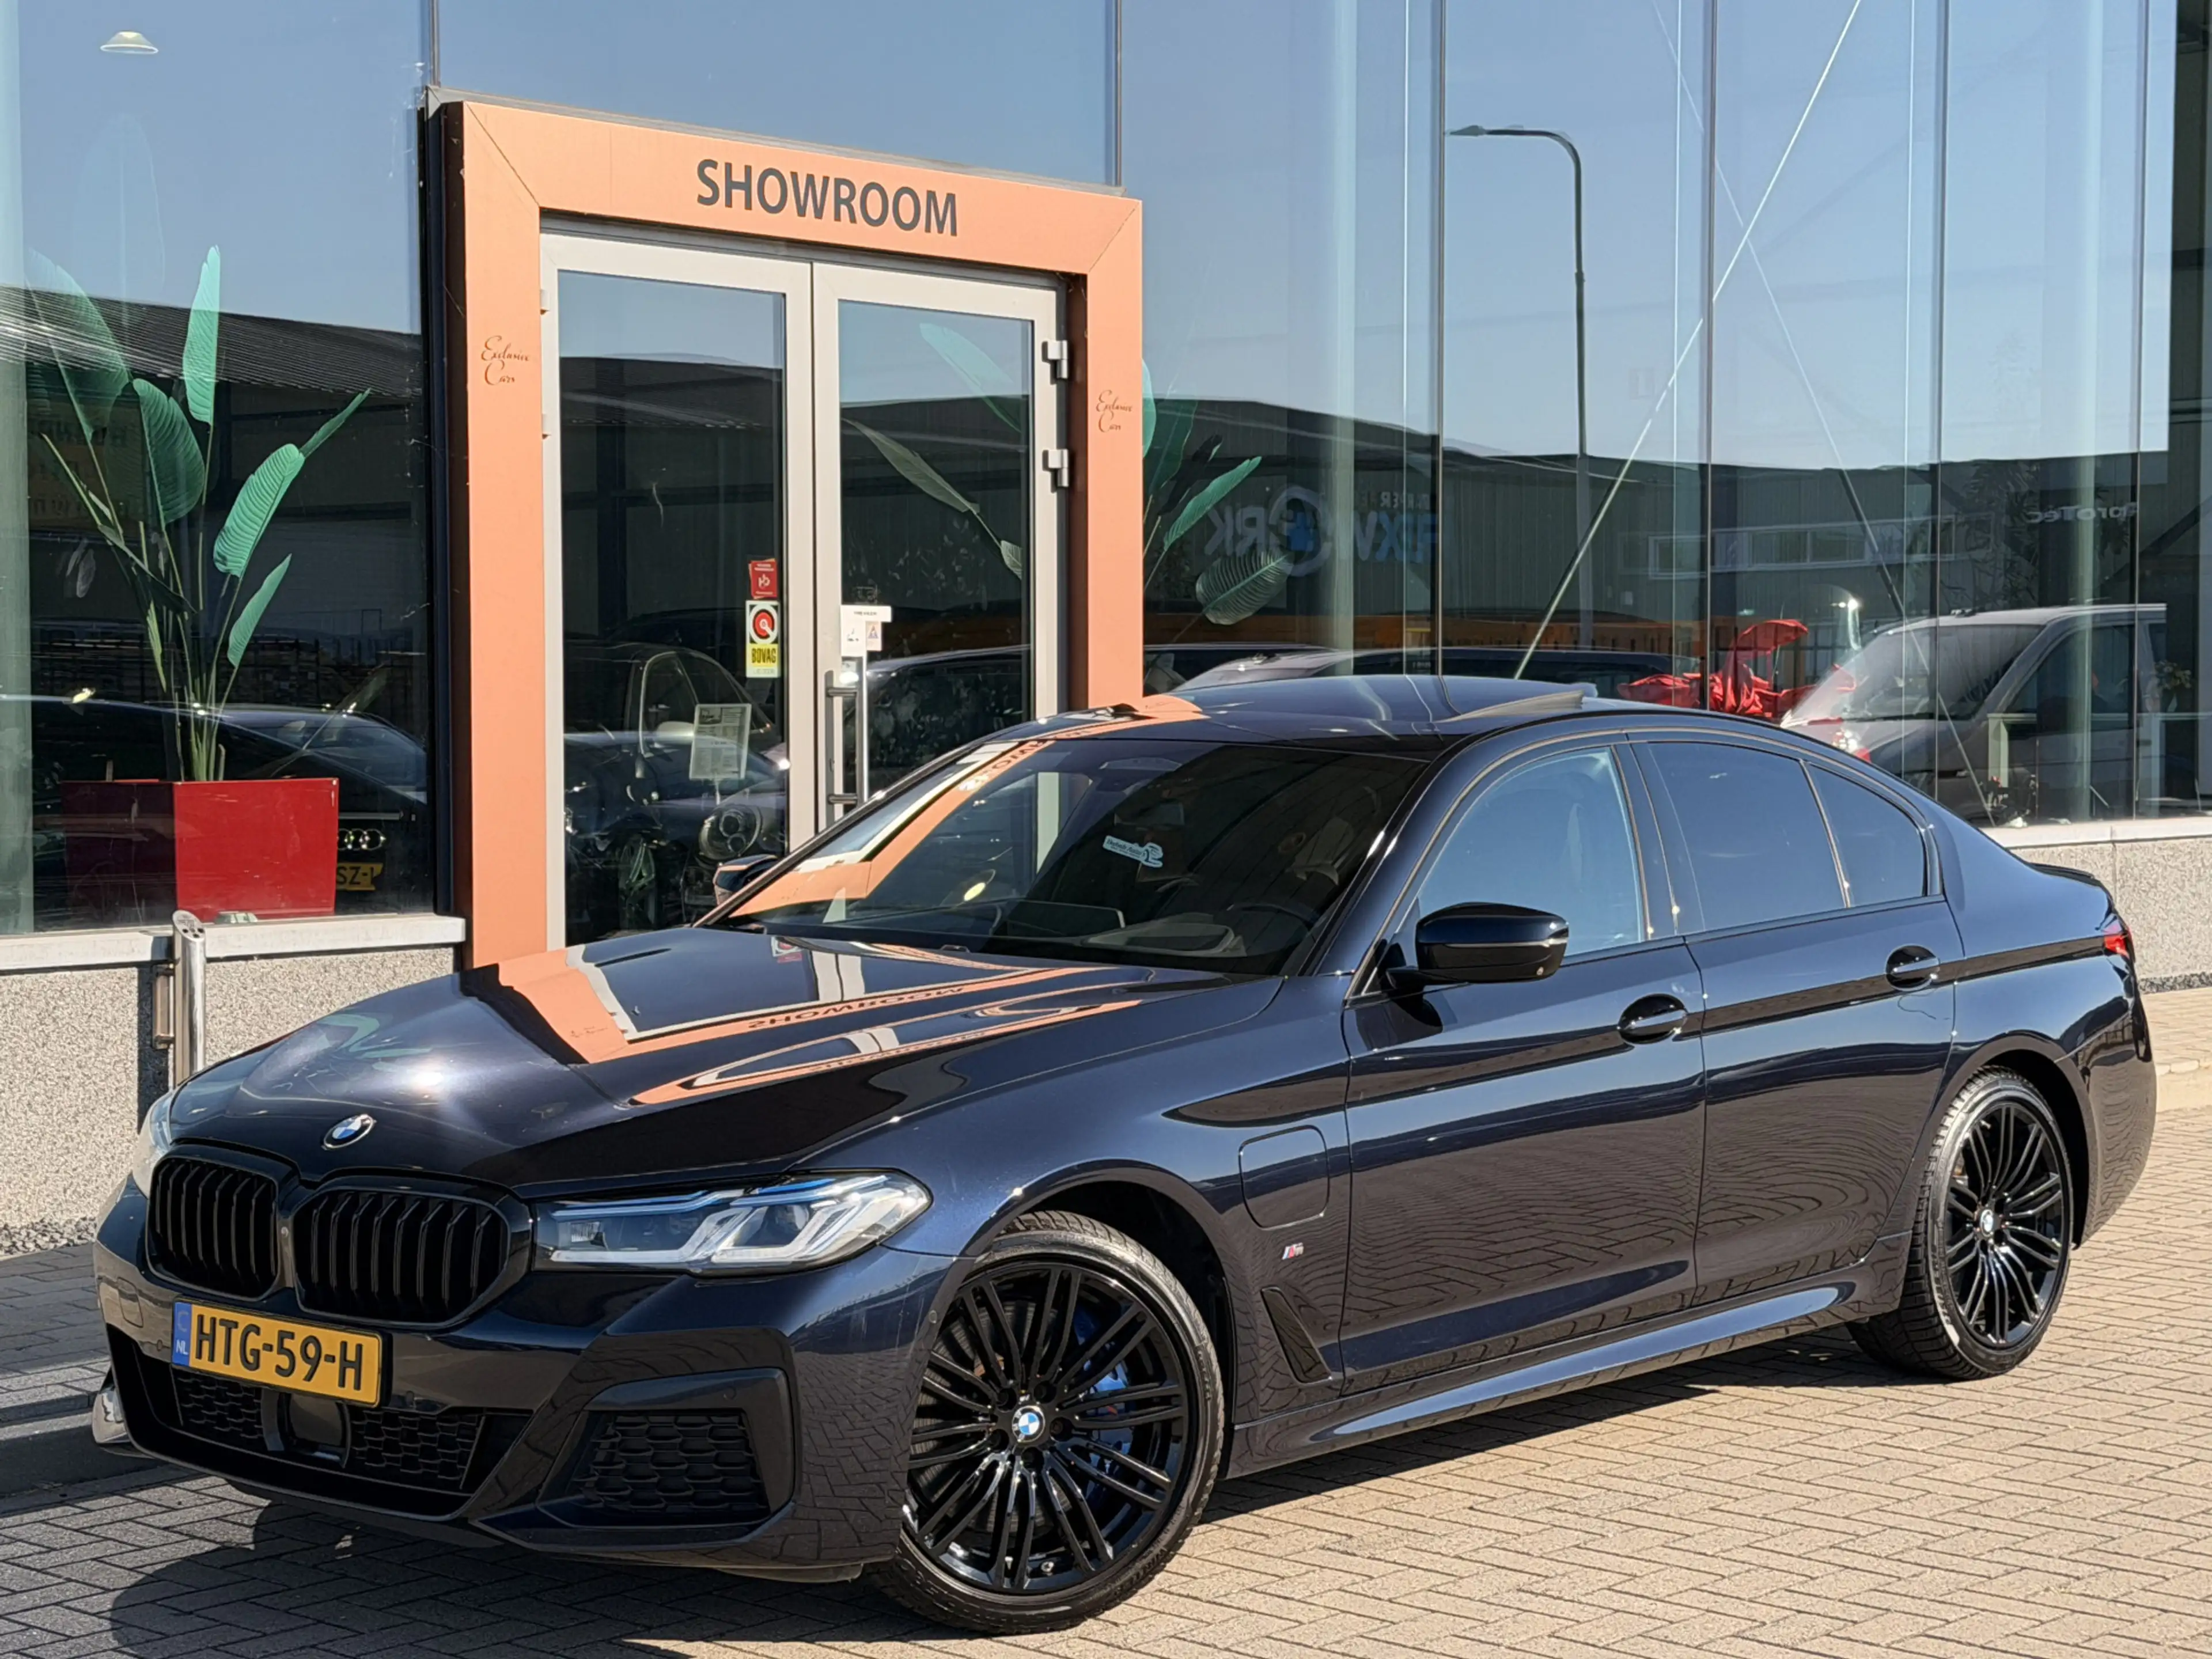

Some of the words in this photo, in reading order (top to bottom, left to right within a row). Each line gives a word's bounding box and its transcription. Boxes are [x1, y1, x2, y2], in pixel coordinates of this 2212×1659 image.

[697, 158, 957, 236] SHOWROOM
[751, 647, 777, 664] BOVAG
[175, 1339, 189, 1355] NL
[195, 1313, 363, 1391] HTG-59-H
